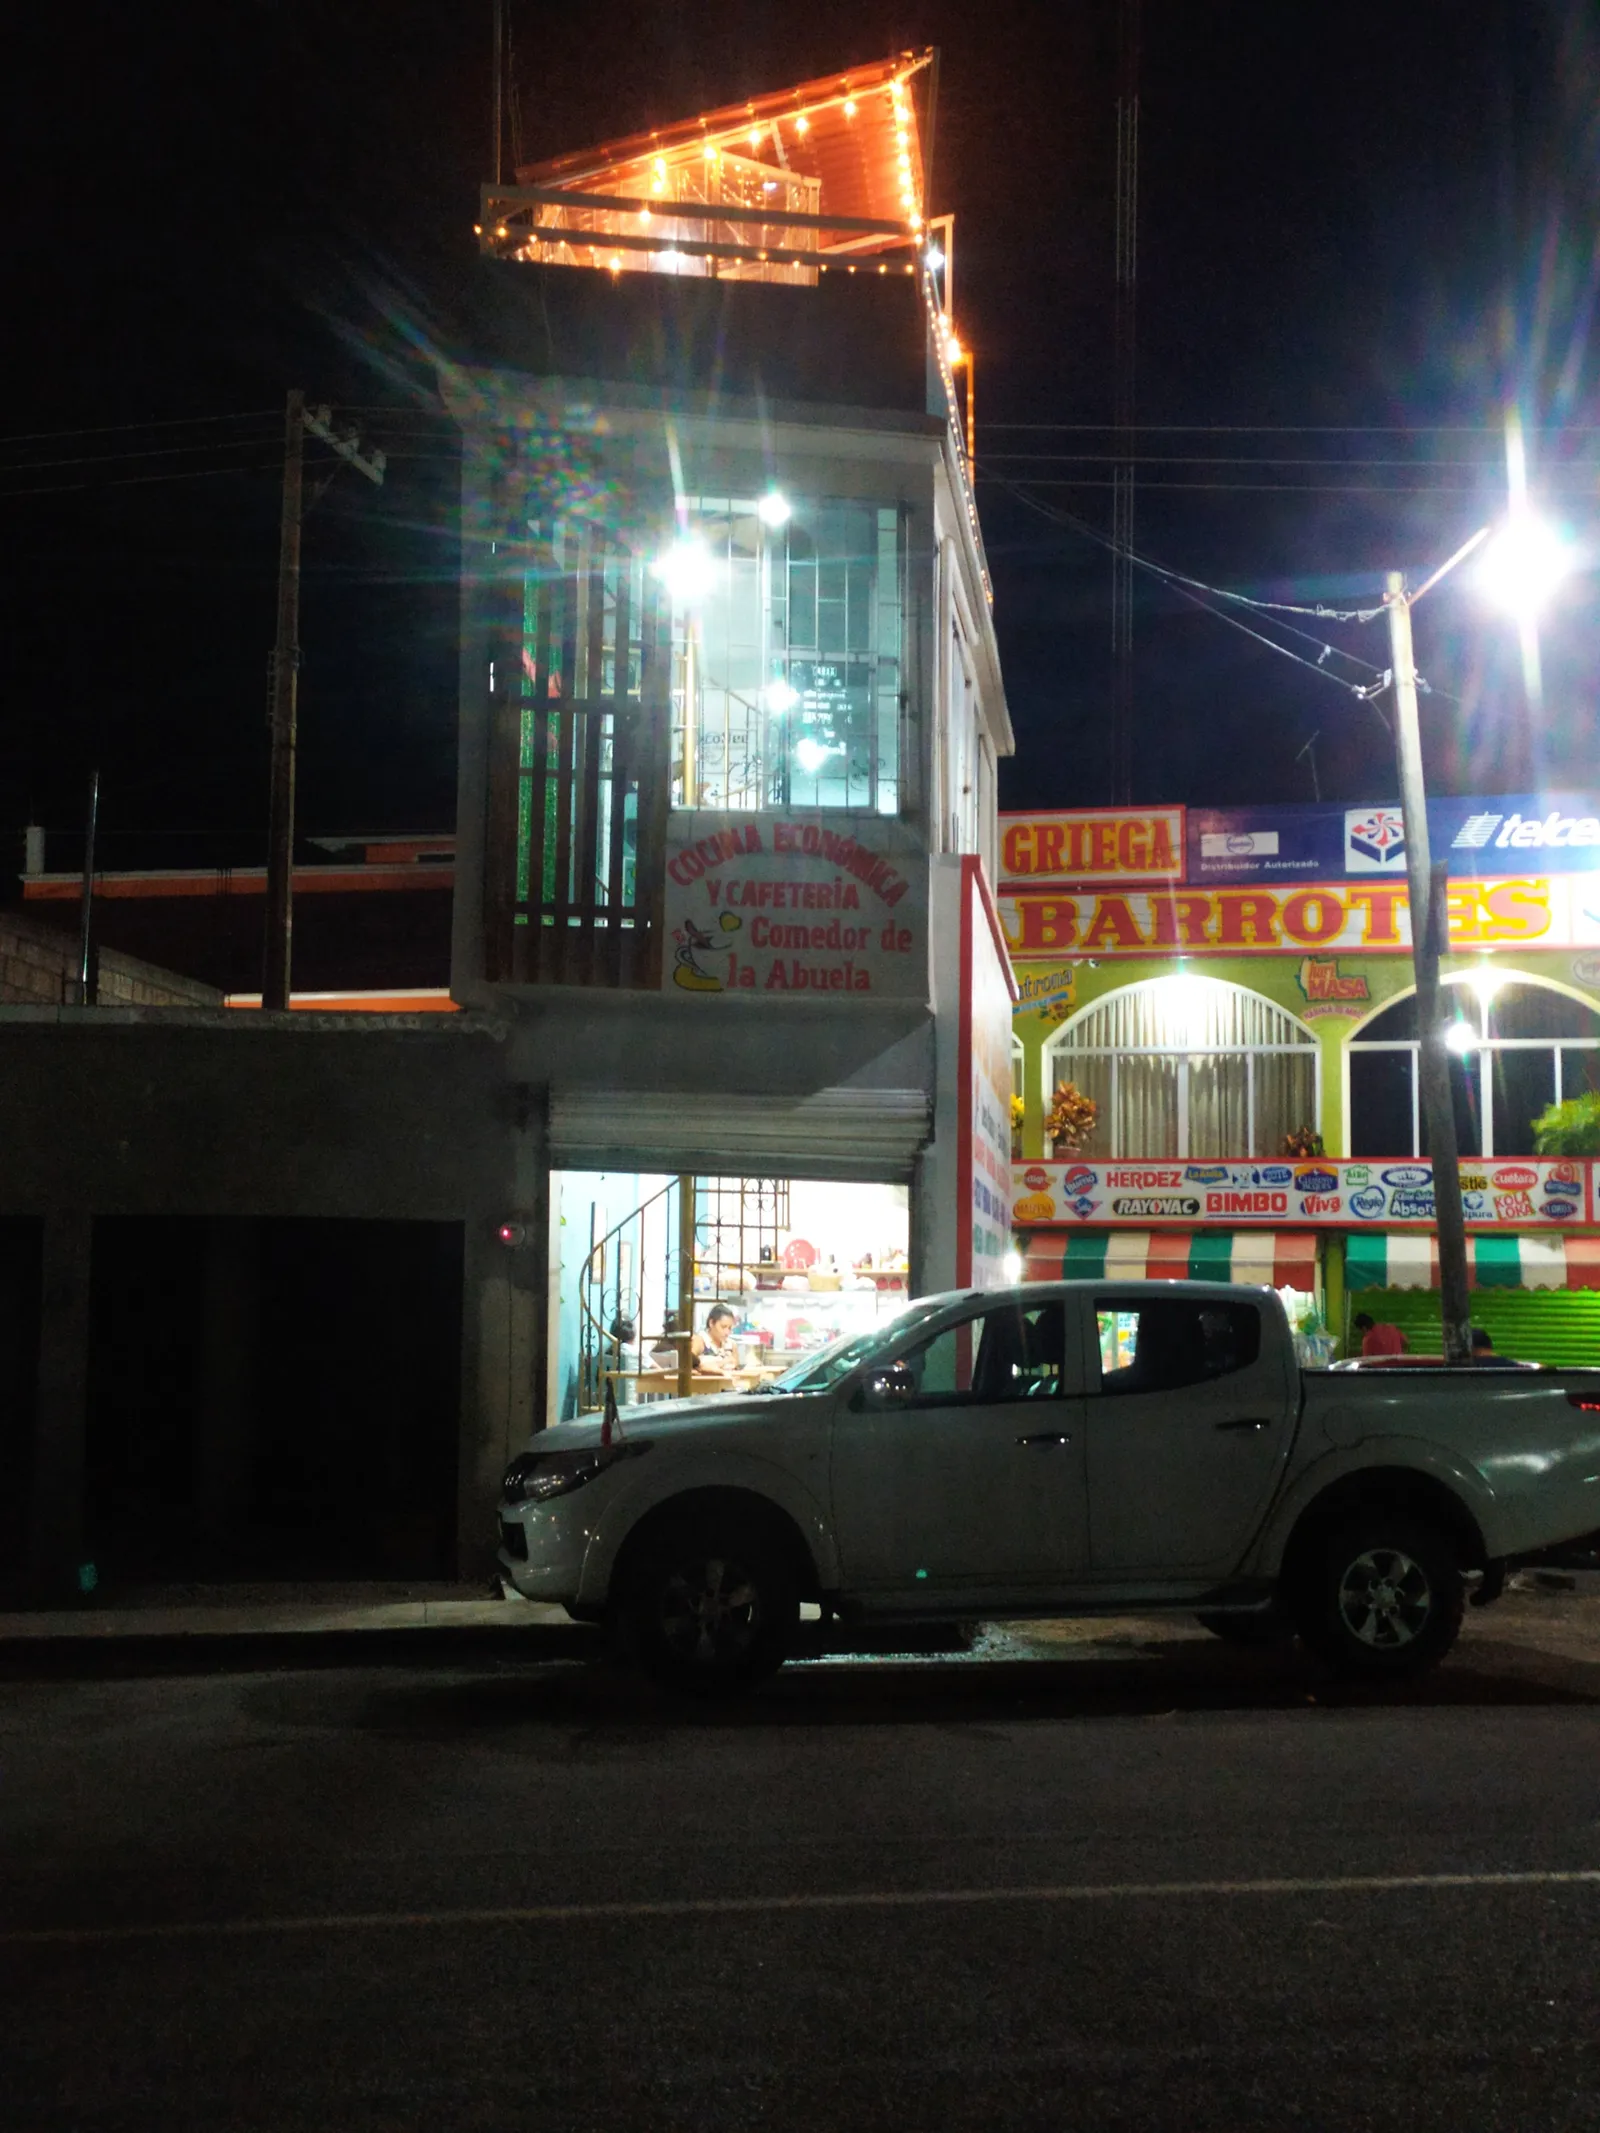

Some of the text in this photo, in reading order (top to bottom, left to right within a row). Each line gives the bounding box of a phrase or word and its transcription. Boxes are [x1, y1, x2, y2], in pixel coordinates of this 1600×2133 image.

[667, 824, 763, 886] COCINA
[1003, 819, 1178, 874] GRIEGA
[706, 879, 722, 907] Y
[751, 916, 912, 952] Comedor de
[727, 953, 870, 991] la Abuela
[1106, 1171, 1182, 1190] HERDEZ
[1118, 1199, 1194, 1215] RAYOVAC
[1206, 1192, 1288, 1212] BIMBO
[1304, 1195, 1341, 1216] Viva
